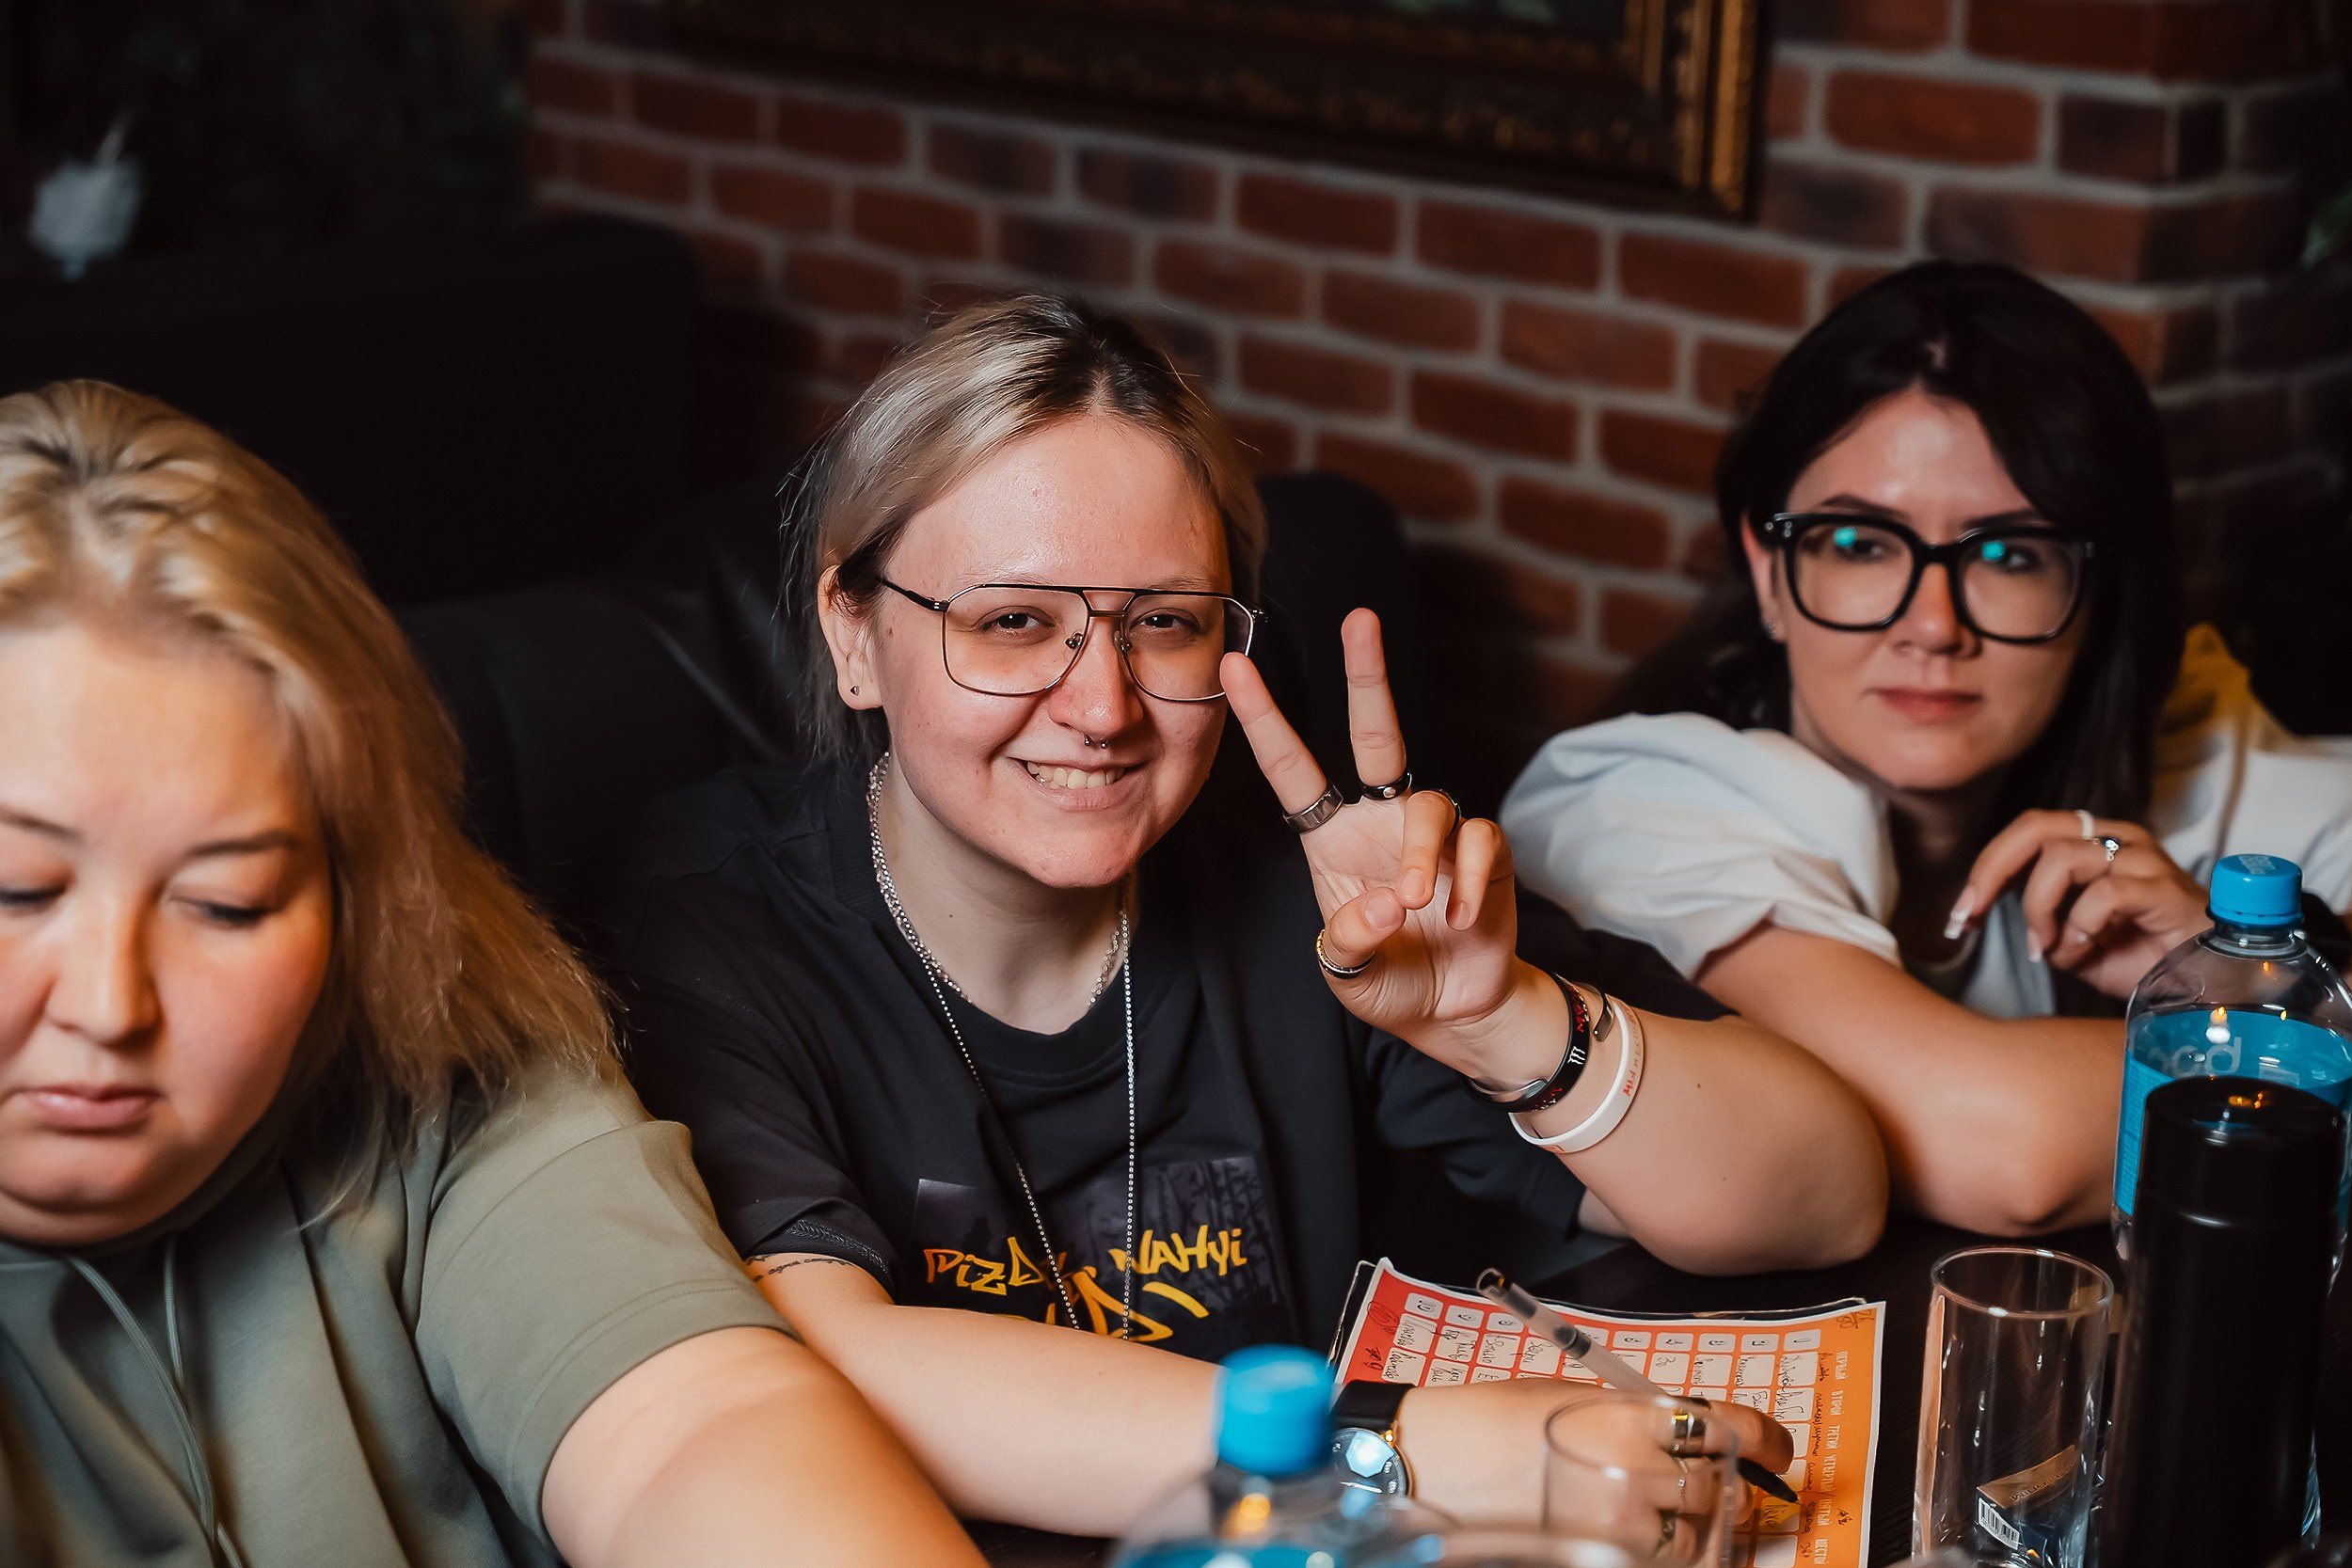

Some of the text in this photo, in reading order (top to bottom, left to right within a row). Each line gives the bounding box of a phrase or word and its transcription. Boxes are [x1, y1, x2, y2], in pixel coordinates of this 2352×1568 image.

[1814, 1351, 1849, 1566] ПЕРВЫЙ ВТОРОЙ ТРЕТИЙ ЧЕТВЕРТЫЙ ПЯТЫЙ ШЕСТОЙ
